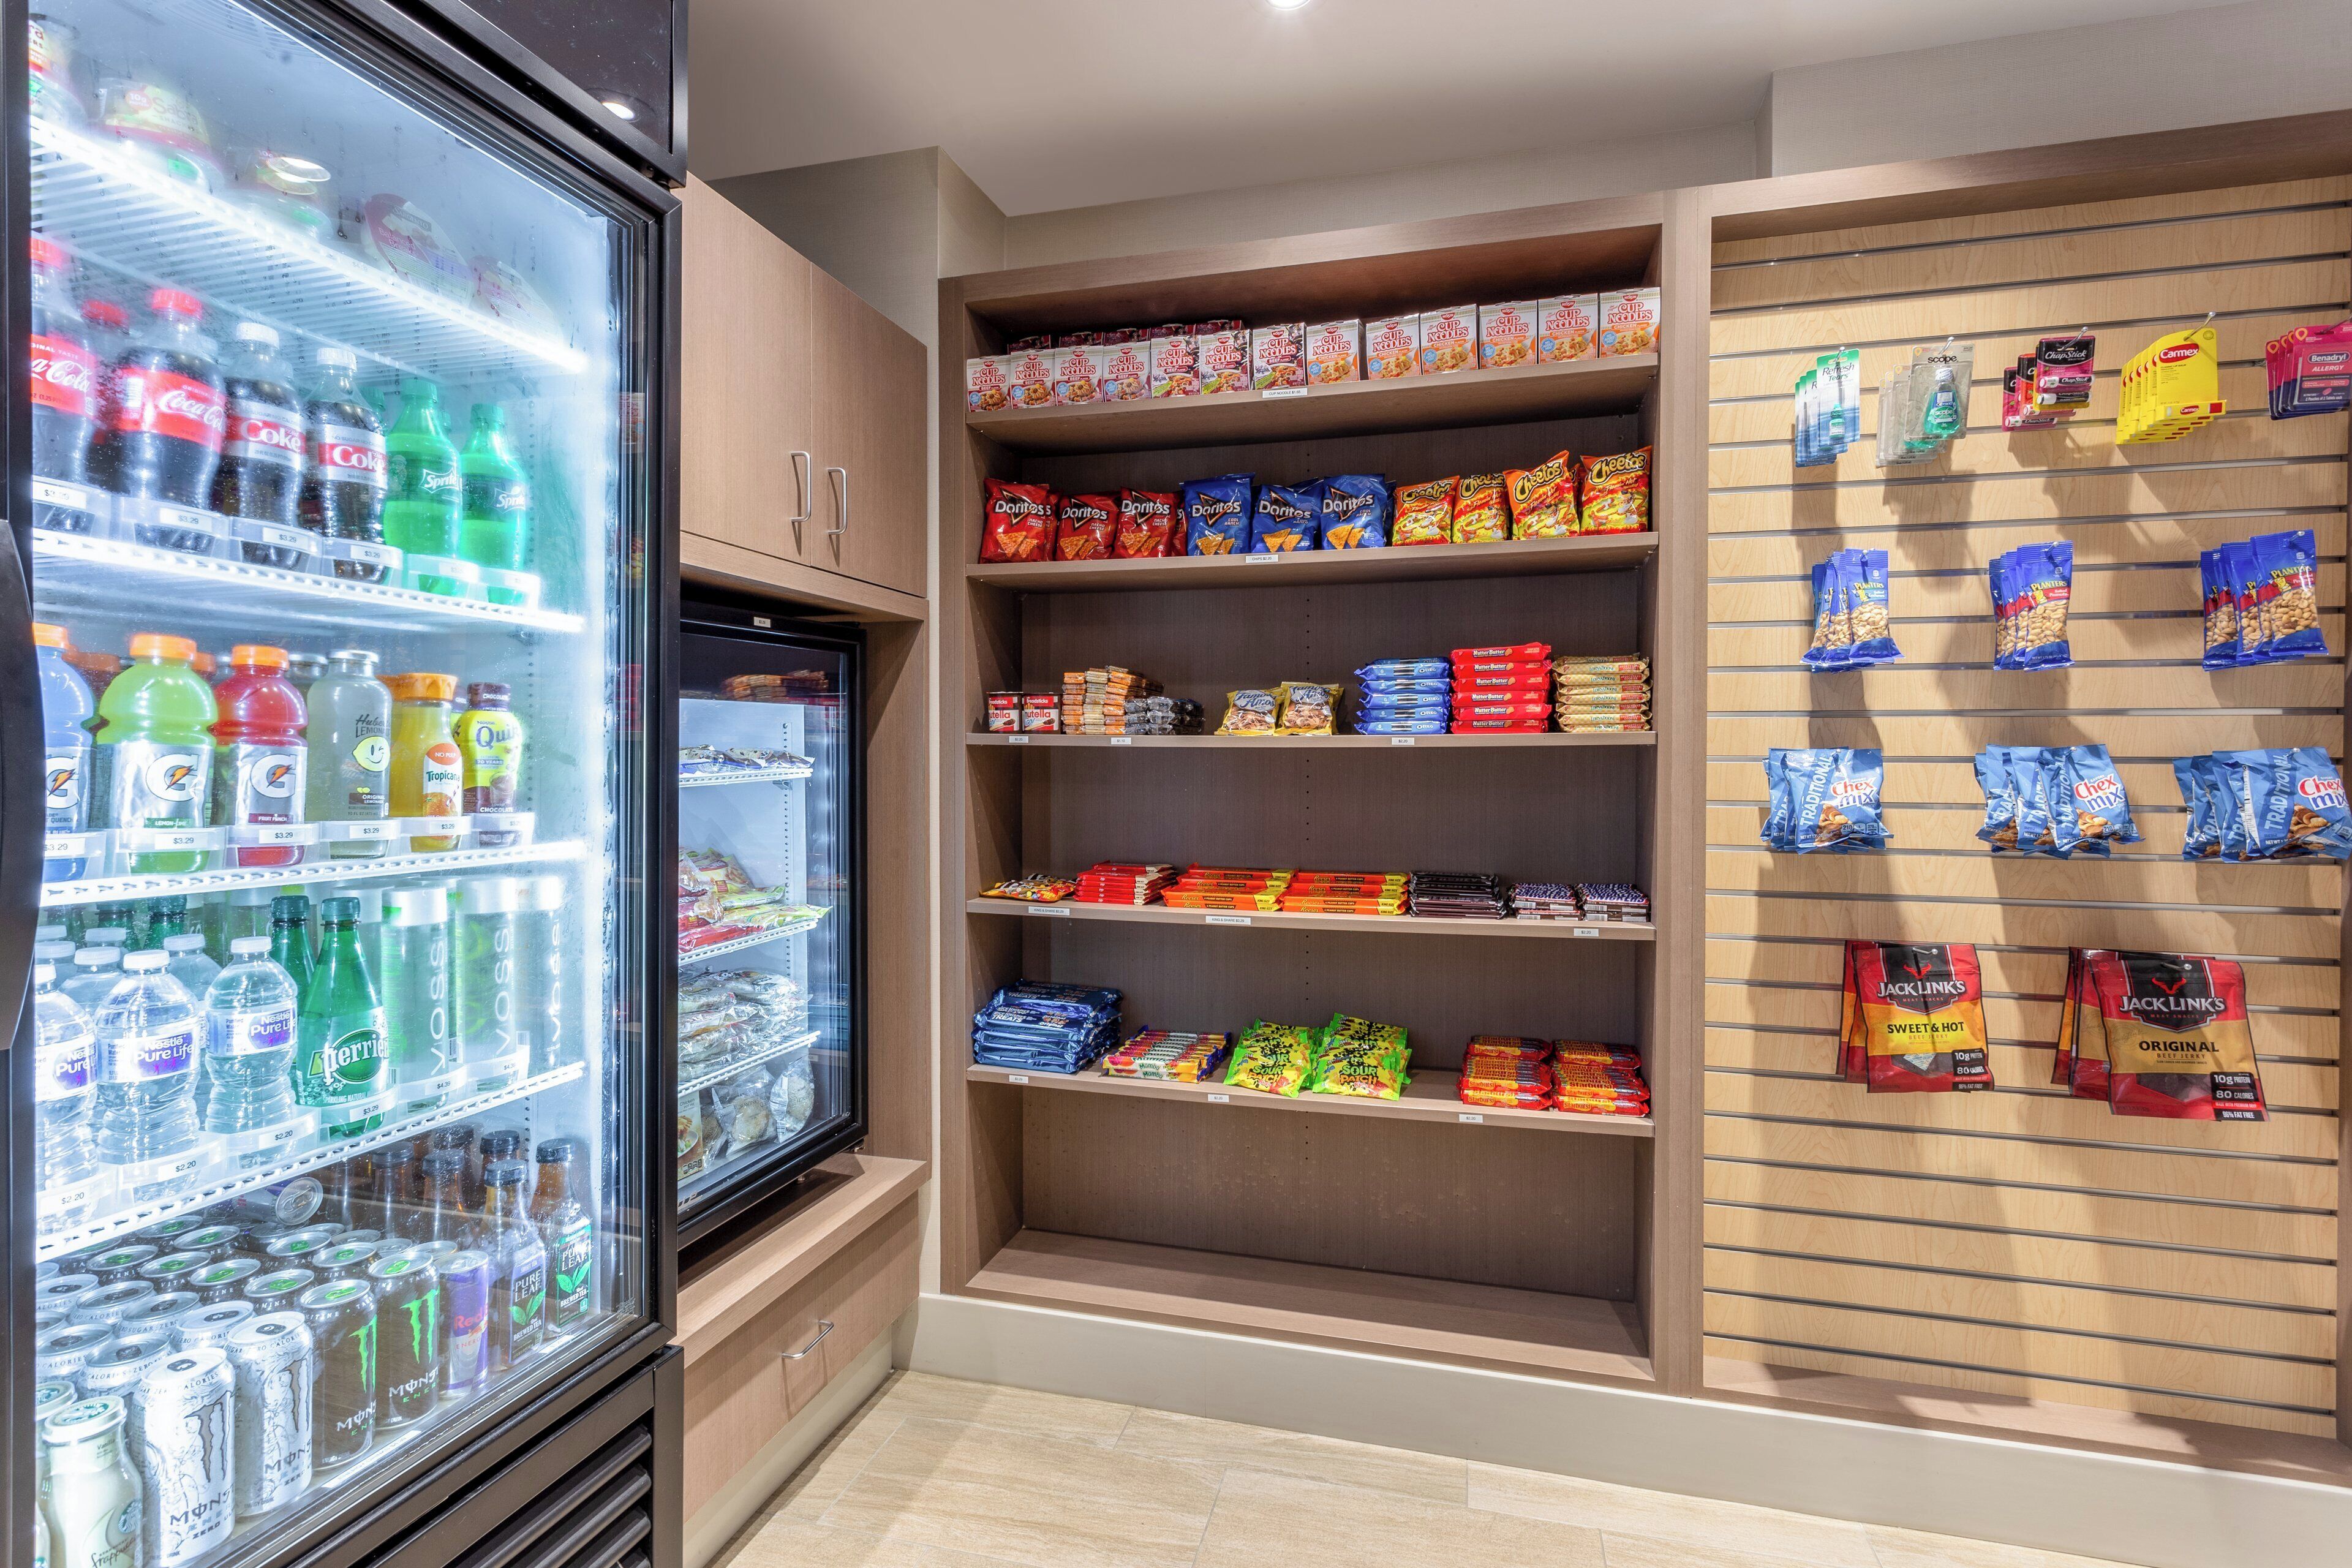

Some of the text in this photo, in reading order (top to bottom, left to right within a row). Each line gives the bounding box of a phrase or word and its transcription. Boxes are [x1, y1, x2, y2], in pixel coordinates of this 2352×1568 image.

[1556, 309, 1581, 320] CUP
[1618, 302, 1644, 314] CUP
[1608, 309, 1653, 324] NOODLES
[1436, 320, 1460, 332] CUP
[1545, 316, 1590, 331] NOODLES
[1381, 330, 1404, 341] CUP
[1427, 326, 1468, 342] NOODLES
[1267, 337, 1289, 349] CUP
[1373, 337, 1412, 352] NOODLES
[1165, 348, 1186, 358] CUP
[1259, 345, 1297, 359] NOODLES
[2045, 350, 2087, 360] ChapStick
[2160, 348, 2198, 359] Carmex
[2312, 353, 2347, 363] Benadryl
[1156, 355, 1194, 368] NOODLES
[1928, 355, 1958, 364] scope
[980, 368, 998, 377] CUP
[1822, 363, 1855, 376] Refresh
[972, 375, 1006, 386] NOODLES
[1828, 373, 1848, 382] Tears
[241, 419, 301, 453] Coke
[333, 445, 385, 473] Coke
[1589, 453, 1647, 484] Cheetos
[1514, 461, 1562, 501] Cheetos
[995, 500, 1044, 514] Doritos
[1121, 500, 1170, 514] Doritos
[1192, 500, 1241, 518] Doritos
[1259, 499, 1311, 519] Doritos
[1322, 494, 1374, 513] Doritos
[1061, 507, 1107, 519] Doritos
[279, 533, 297, 543] $3.29
[364, 549, 380, 559] $3.29
[2031, 581, 2067, 592] PLANTERS
[1240, 698, 1275, 708] Amos
[1025, 709, 1051, 719] nutella
[146, 753, 199, 802] G
[251, 754, 297, 798] G
[426, 770, 460, 783] Tropicana
[1800, 754, 1834, 826] TRADITIONAL
[1832, 777, 1875, 796] Chex
[2075, 774, 2117, 799] Chex
[2264, 755, 2292, 829] TRADITIONAL
[2299, 777, 2343, 797] Chex
[1838, 789, 1875, 808] mix
[2087, 787, 2124, 812] mix
[2312, 791, 2348, 810] mix
[1877, 980, 1966, 997] JACK LINK'S
[2120, 996, 2225, 1012] JACK LINK'S
[251, 1023, 281, 1037] Pure
[1887, 1022, 1964, 1034] SWEET & HOT
[2138, 1040, 2220, 1052] ORIGINAL
[137, 1043, 194, 1063] Pure Life
[1954, 1052, 1970, 1061] 10g
[1252, 1065, 1284, 1074] SOUR
[1341, 1064, 1378, 1076] SOUR
[1248, 1071, 1281, 1083] PATCH
[1340, 1074, 1378, 1085] PATCH
[2214, 1074, 2234, 1085] 10g
[437, 1080, 451, 1089] $4.39
[363, 1104, 379, 1115] $3.29
[274, 1129, 293, 1140] $2.20
[175, 1160, 197, 1172] $2.20
[61, 1192, 85, 1205] $2.20
[515, 1269, 541, 1292] PURE
[514, 1282, 541, 1302] LEAF
[560, 1290, 587, 1307] BREWED TEA
[513, 1320, 542, 1341] BREWED TEA
